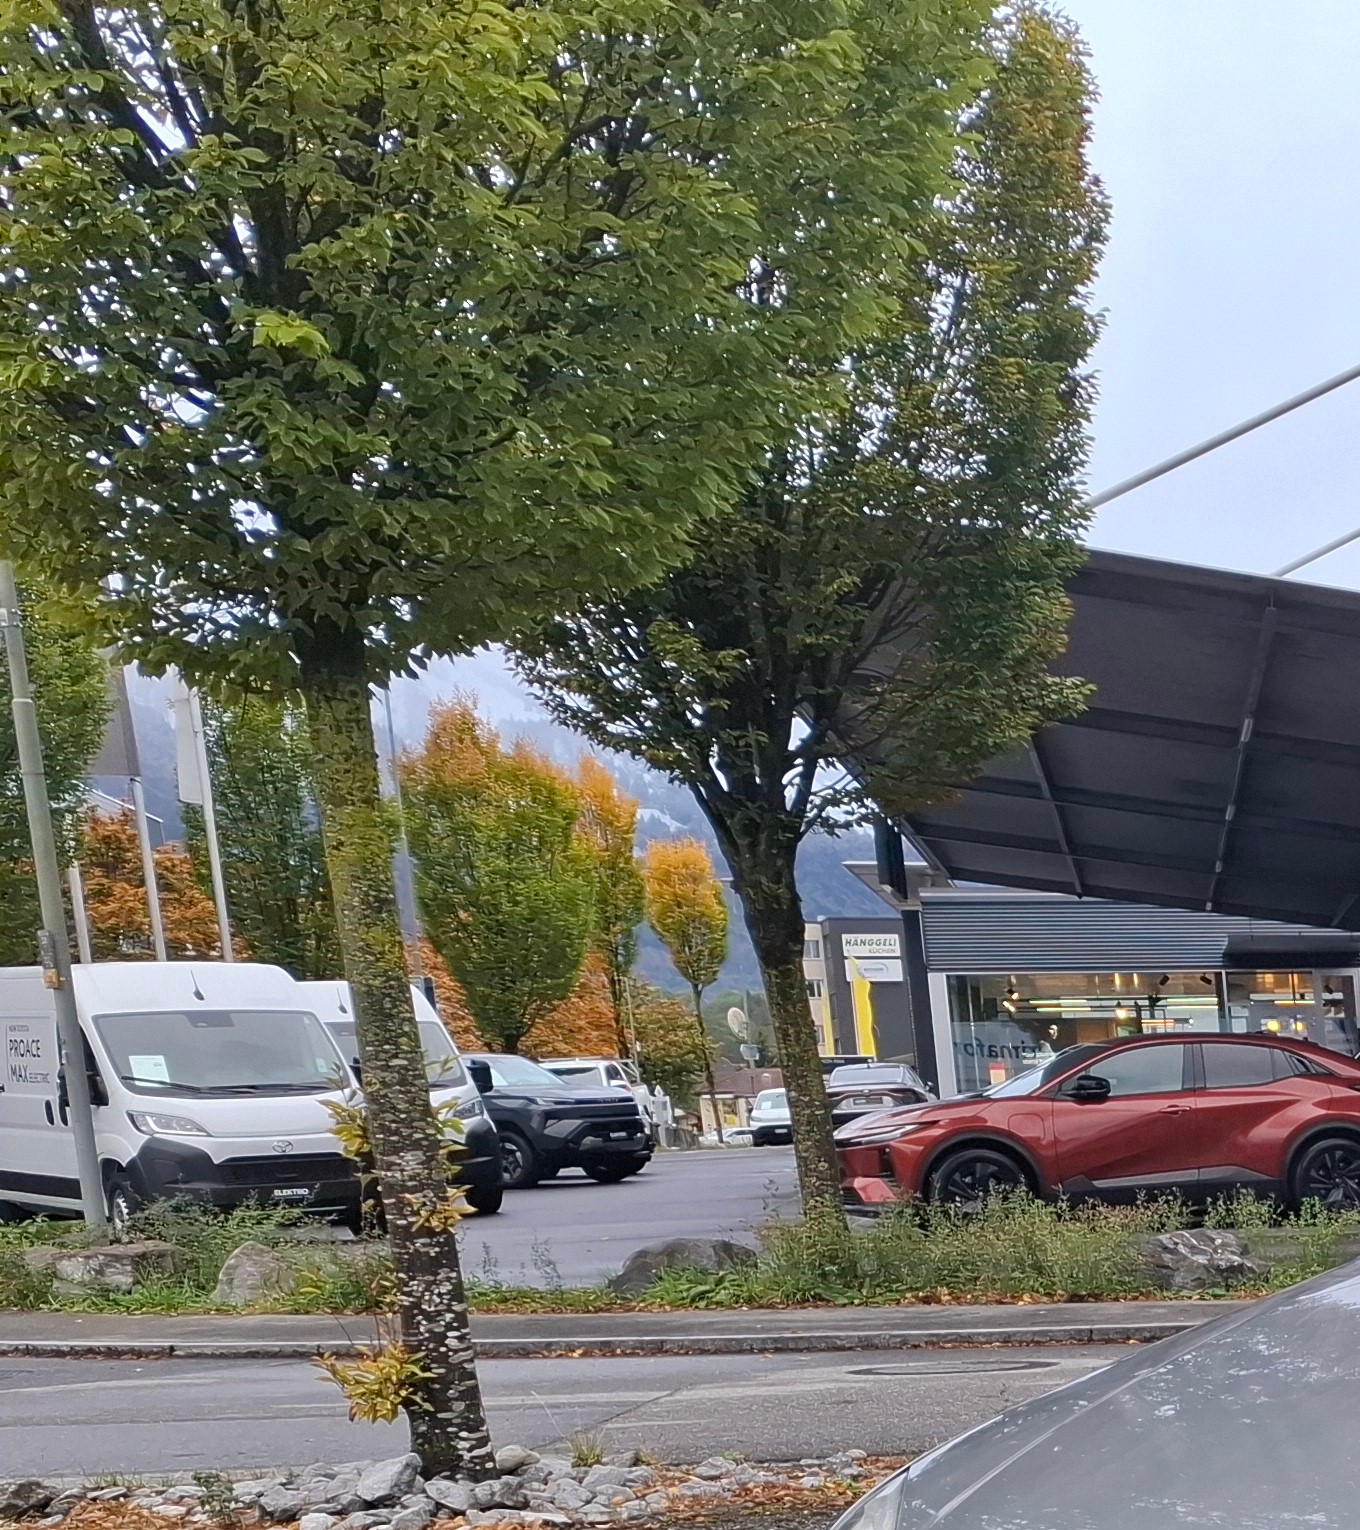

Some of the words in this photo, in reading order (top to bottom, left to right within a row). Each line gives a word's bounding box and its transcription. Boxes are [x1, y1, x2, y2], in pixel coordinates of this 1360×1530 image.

[845, 936, 897, 947] HÄNGGELI
[9, 1039, 41, 1058] PROACE
[10, 1064, 28, 1083] MAX
